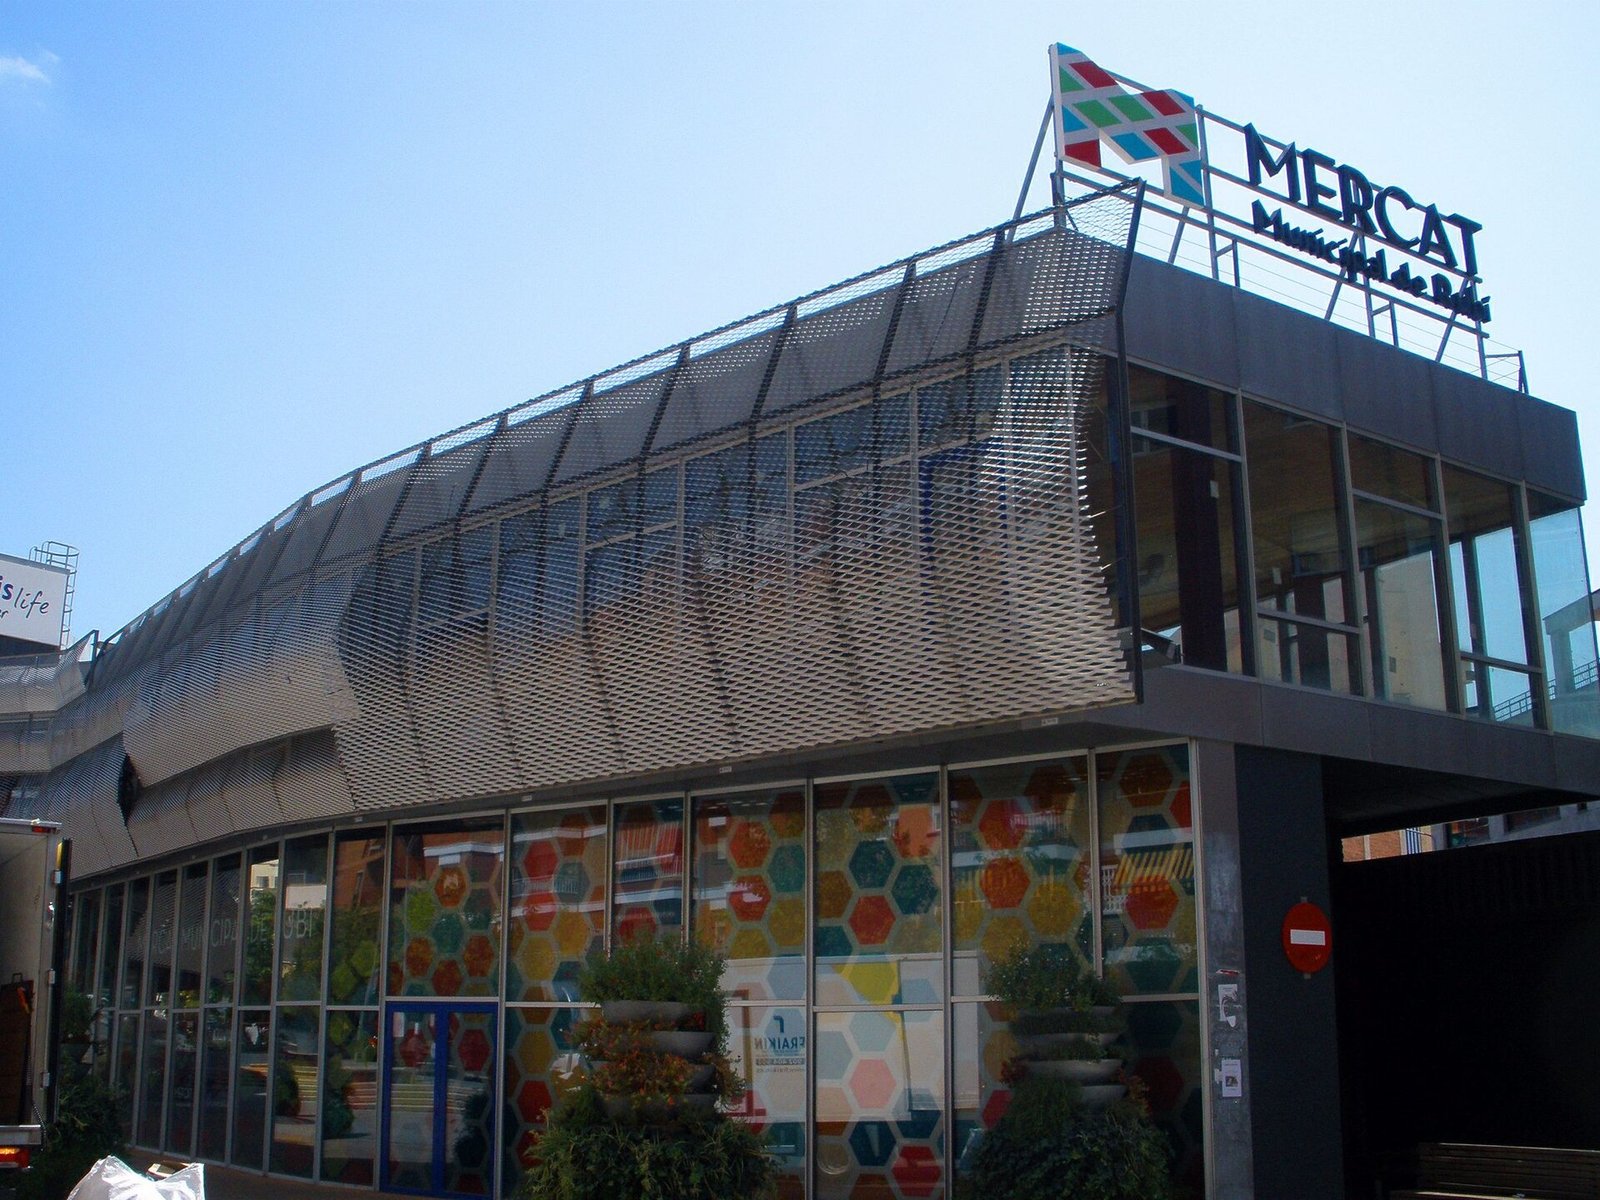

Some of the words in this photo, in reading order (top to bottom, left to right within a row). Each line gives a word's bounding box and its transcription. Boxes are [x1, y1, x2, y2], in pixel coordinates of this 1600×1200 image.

[1243, 122, 1482, 276] MERCAT
[1251, 199, 1388, 283] Municipal
[1391, 262, 1428, 298] de
[14, 587, 49, 619] life
